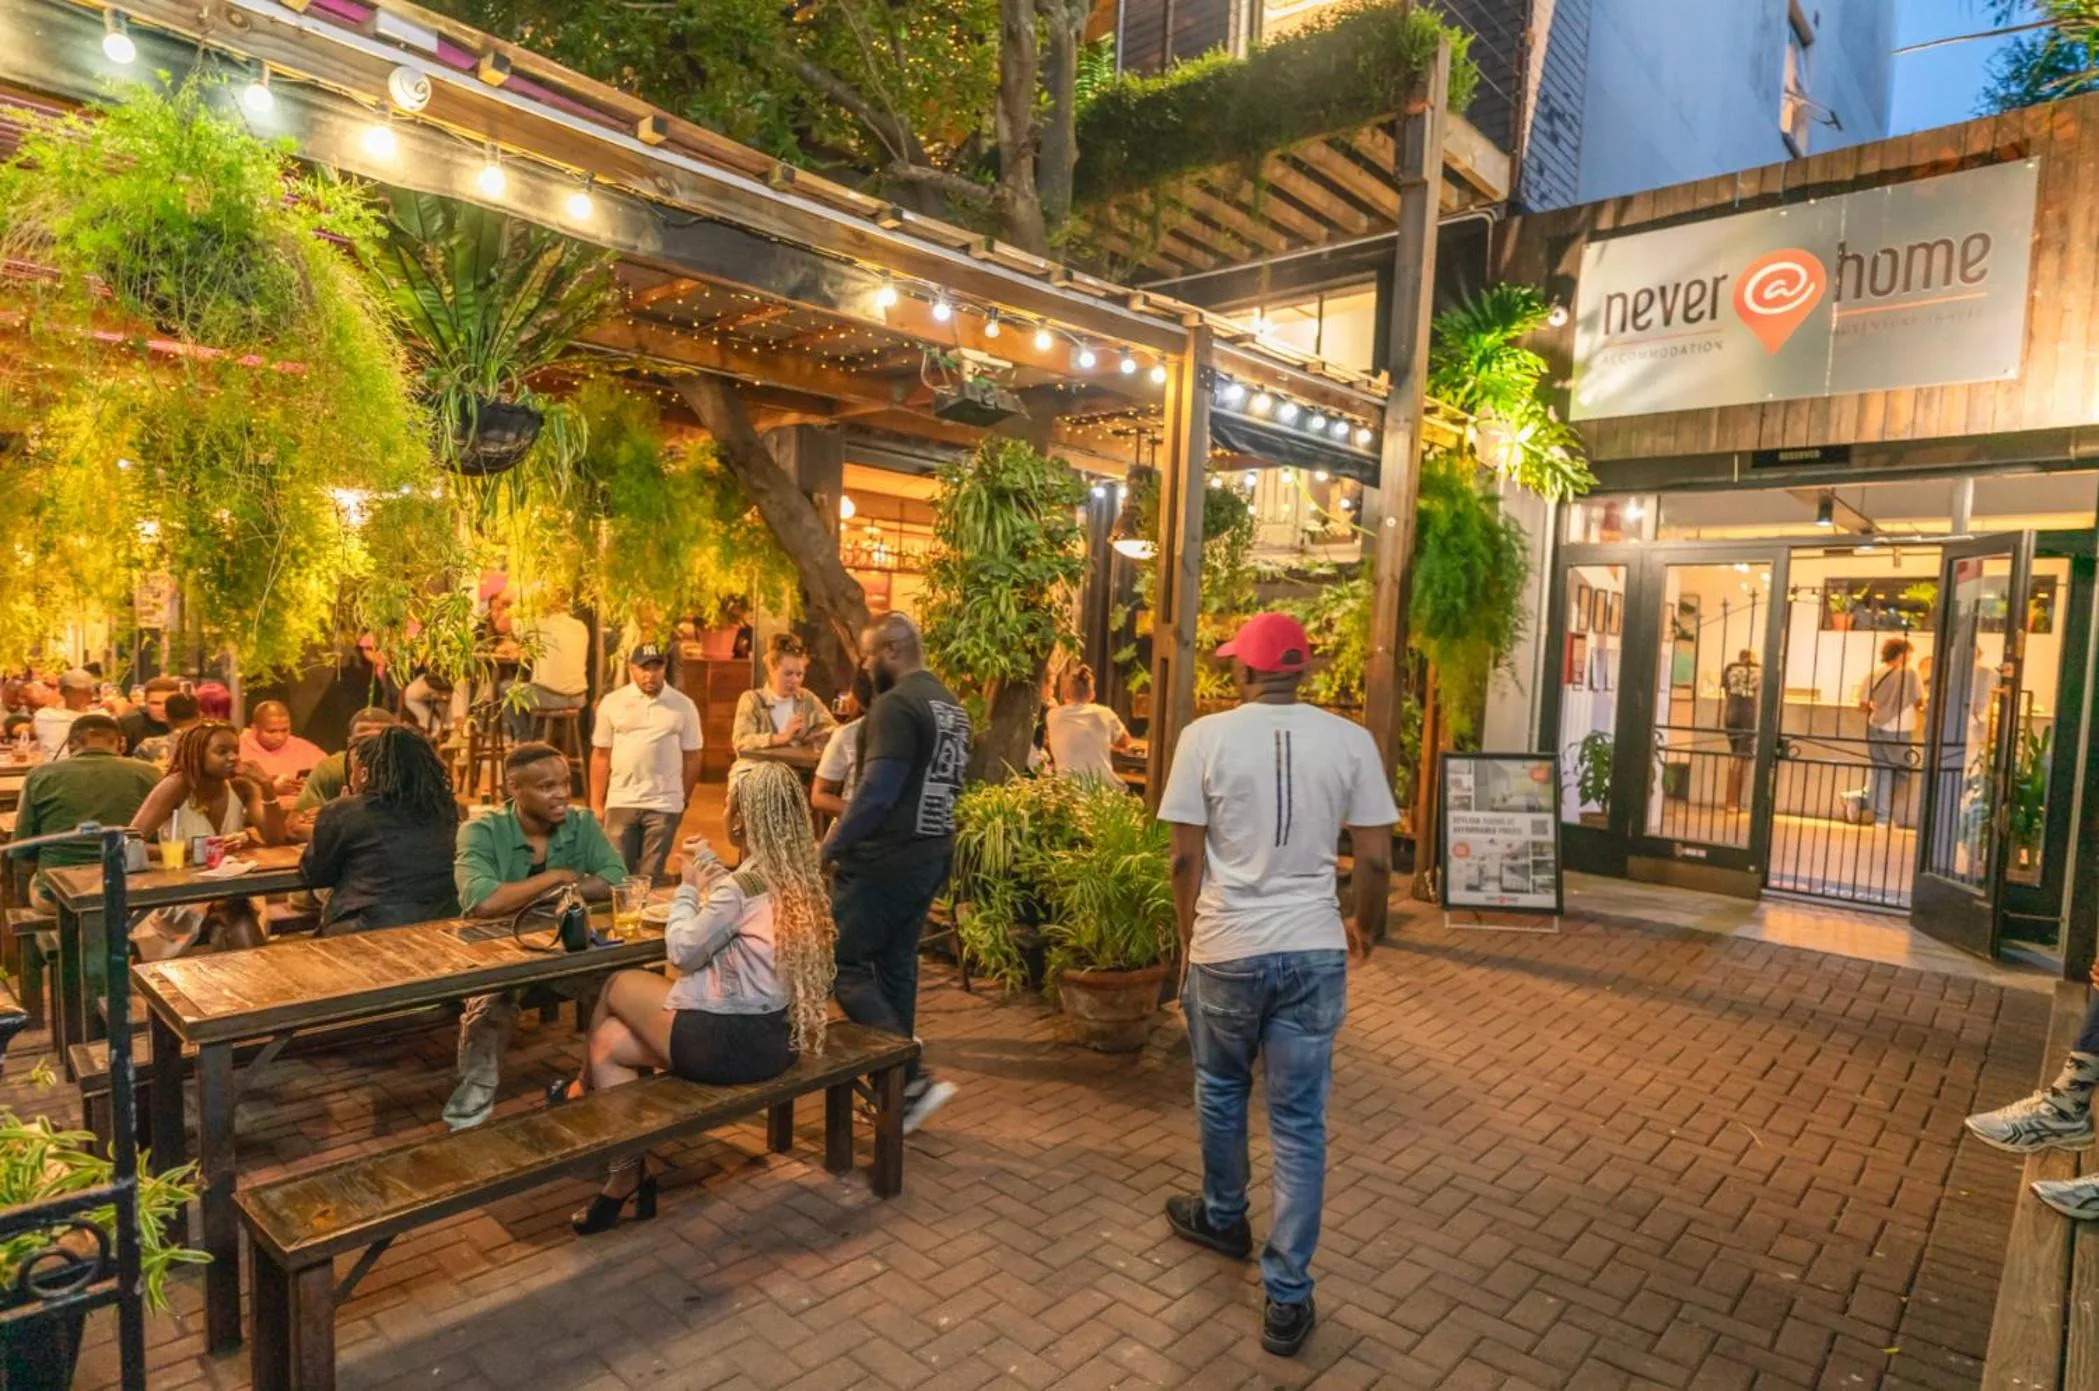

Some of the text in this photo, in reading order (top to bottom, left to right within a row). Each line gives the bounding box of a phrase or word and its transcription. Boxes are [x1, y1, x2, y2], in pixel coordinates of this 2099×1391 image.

[1604, 231, 1992, 336] never @ home
[1603, 339, 1724, 365] ACCOMMODATION
